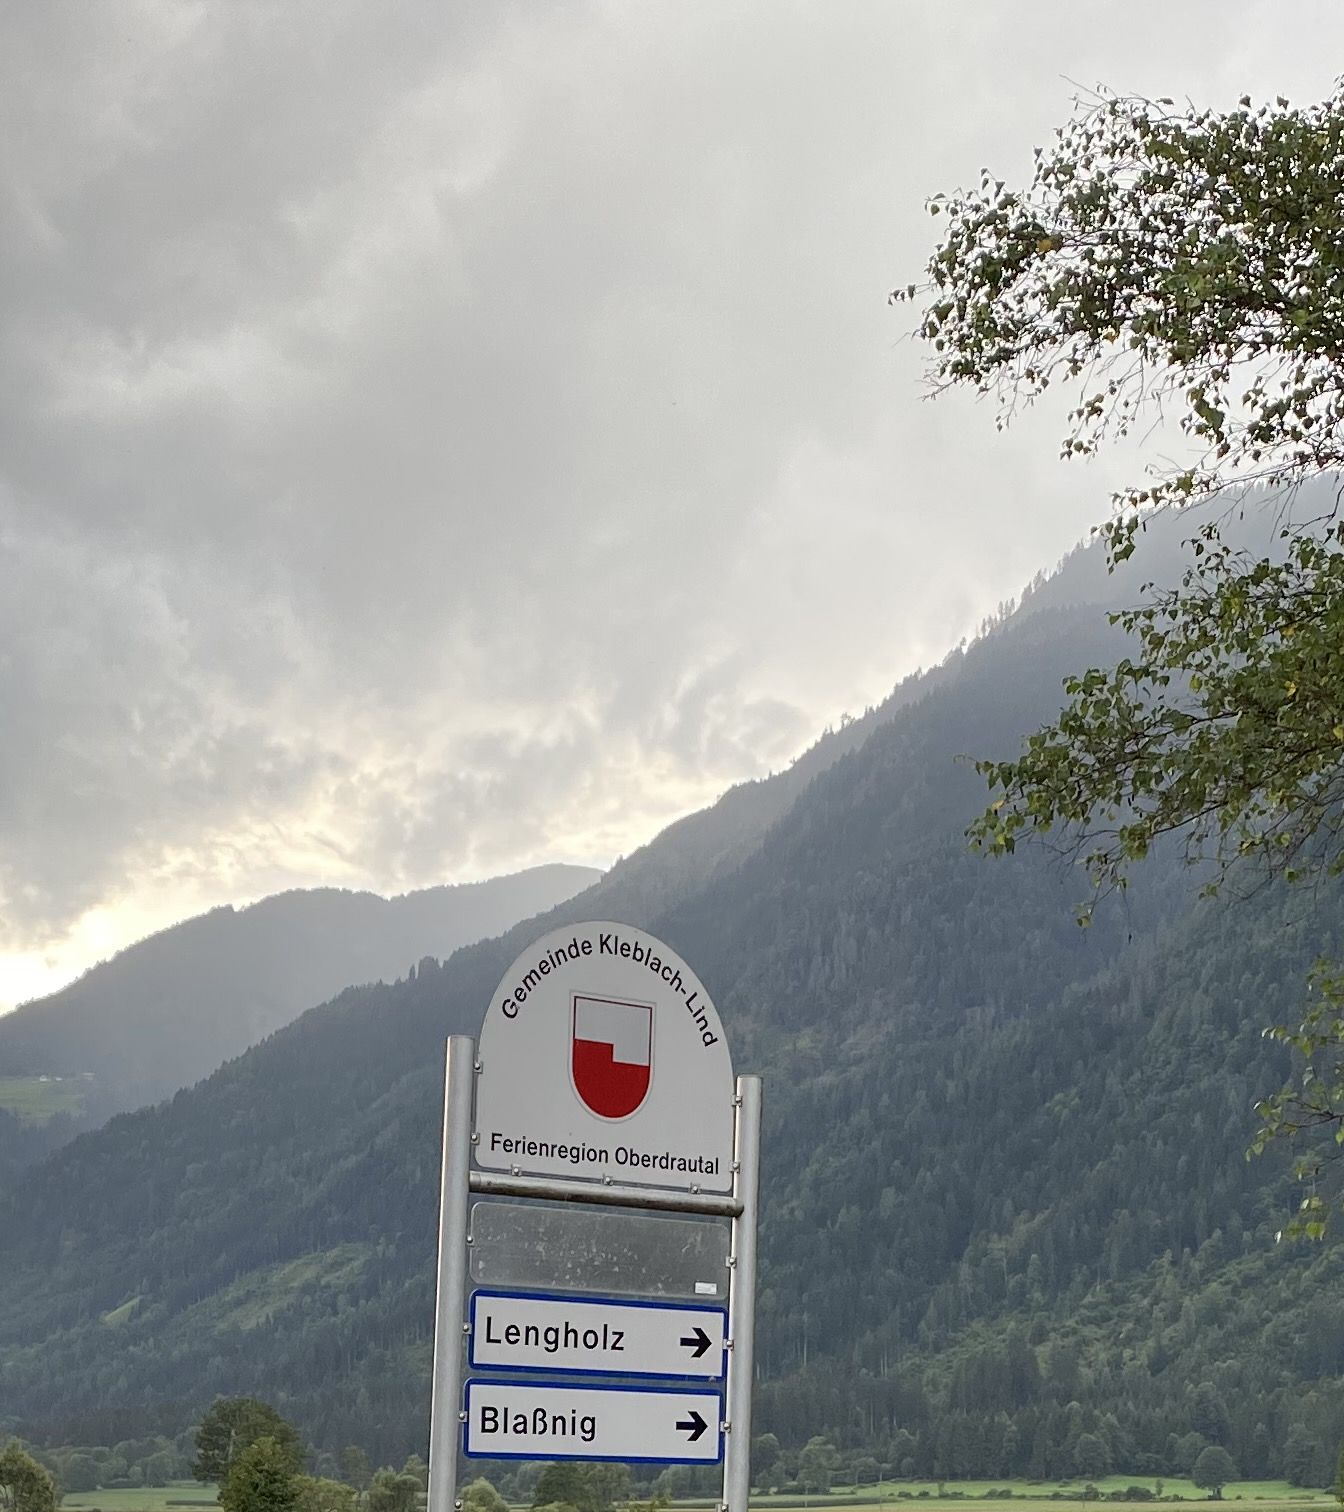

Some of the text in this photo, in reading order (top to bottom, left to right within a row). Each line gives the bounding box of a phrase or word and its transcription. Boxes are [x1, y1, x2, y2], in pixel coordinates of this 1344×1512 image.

[501, 933, 718, 1048] Gemeinde Kleblach-Lind
[490, 1132, 719, 1175] Ferienregion Oberdrautal
[485, 1316, 625, 1353] Lengholz
[479, 1406, 597, 1442] Blaßnig
